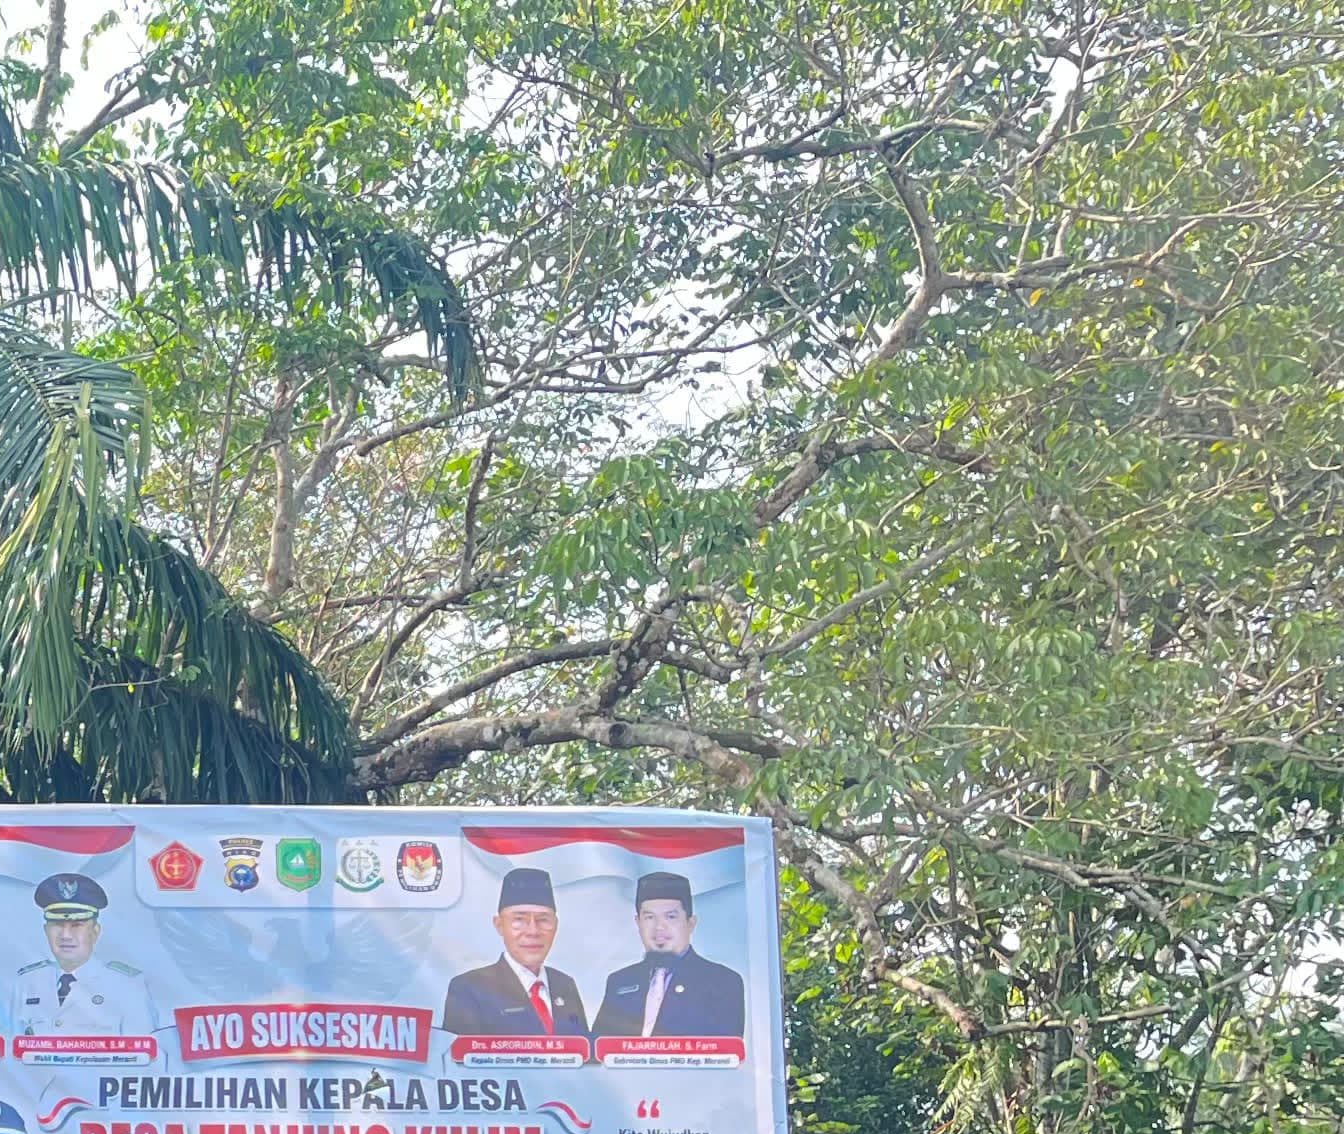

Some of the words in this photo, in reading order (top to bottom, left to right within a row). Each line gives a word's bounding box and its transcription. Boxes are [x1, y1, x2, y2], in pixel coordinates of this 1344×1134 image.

[191, 1013, 243, 1052] AYO
[252, 1011, 417, 1052] SUKSESKAN
[99, 1077, 286, 1109] PEMILIHAN
[299, 1078, 429, 1110] KEPALA
[438, 1078, 527, 1111] DESA
